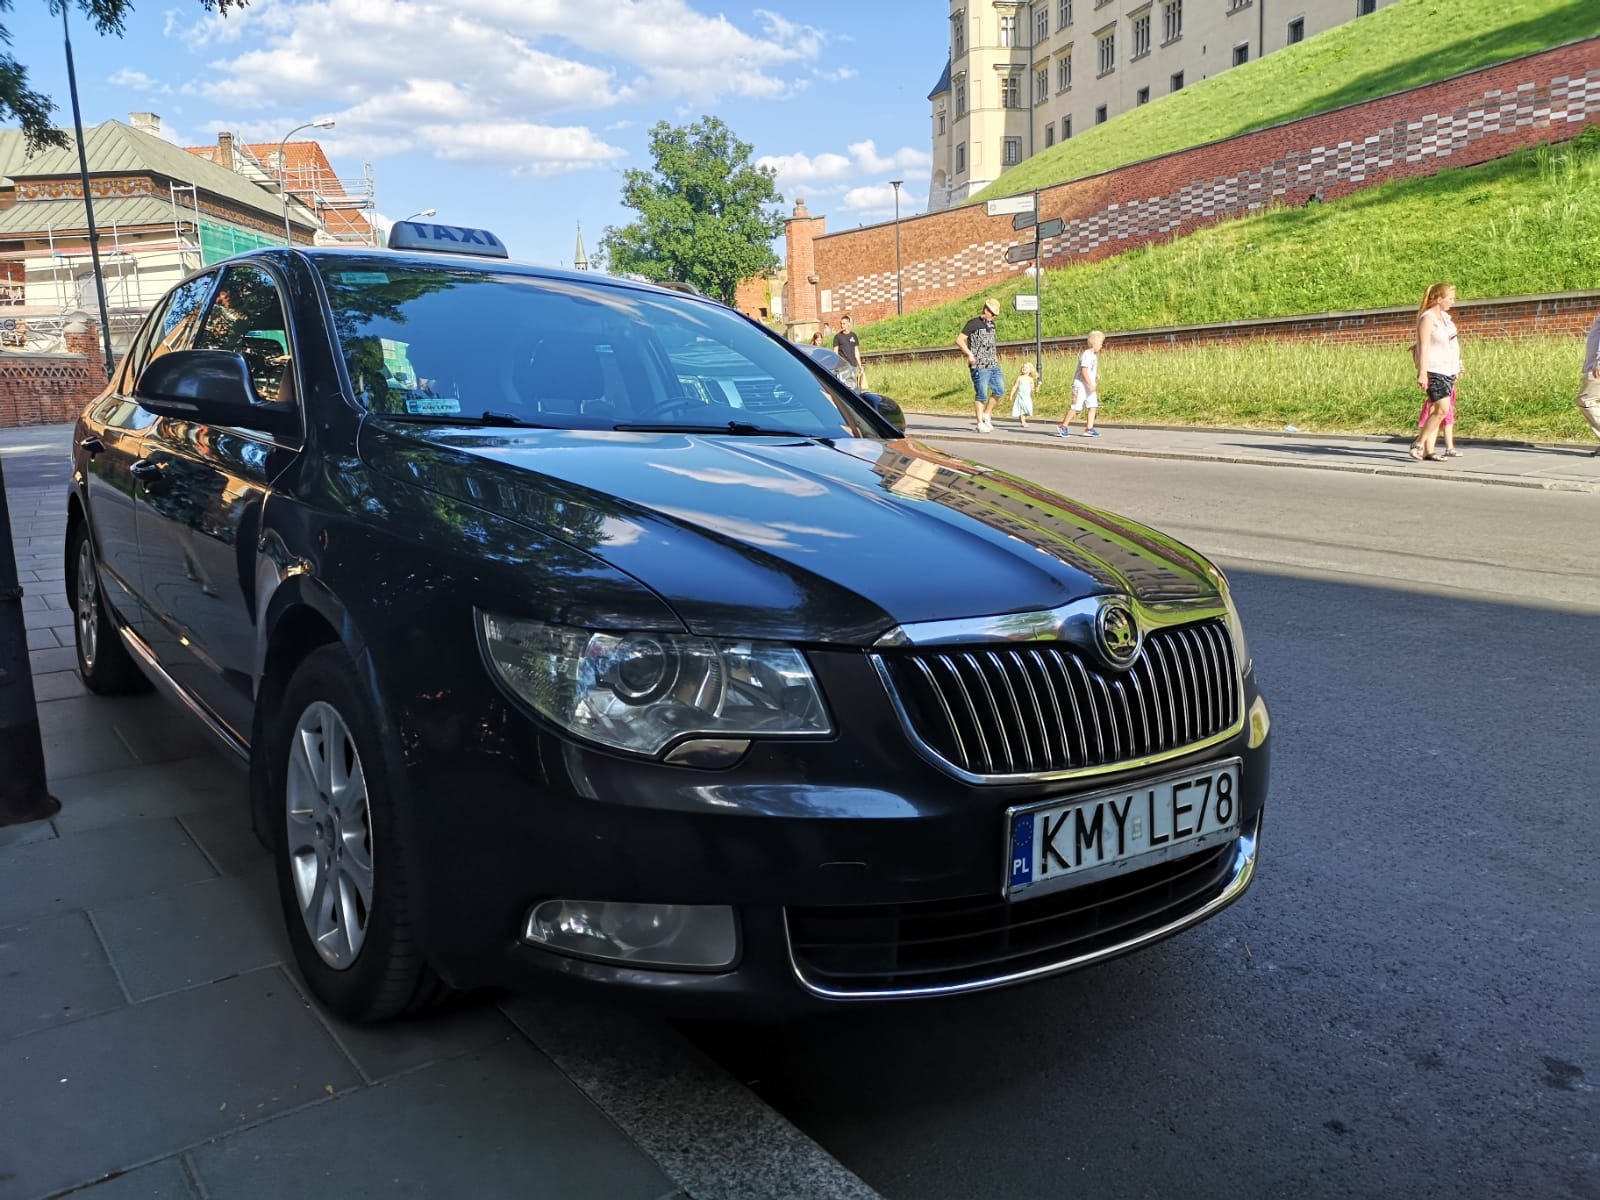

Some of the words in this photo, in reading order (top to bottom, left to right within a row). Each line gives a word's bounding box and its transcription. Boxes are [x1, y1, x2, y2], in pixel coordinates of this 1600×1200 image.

[409, 222, 498, 247] TAXI
[1041, 796, 1133, 874] KMY
[1148, 772, 1233, 847] LE78
[1012, 857, 1030, 876] PL
